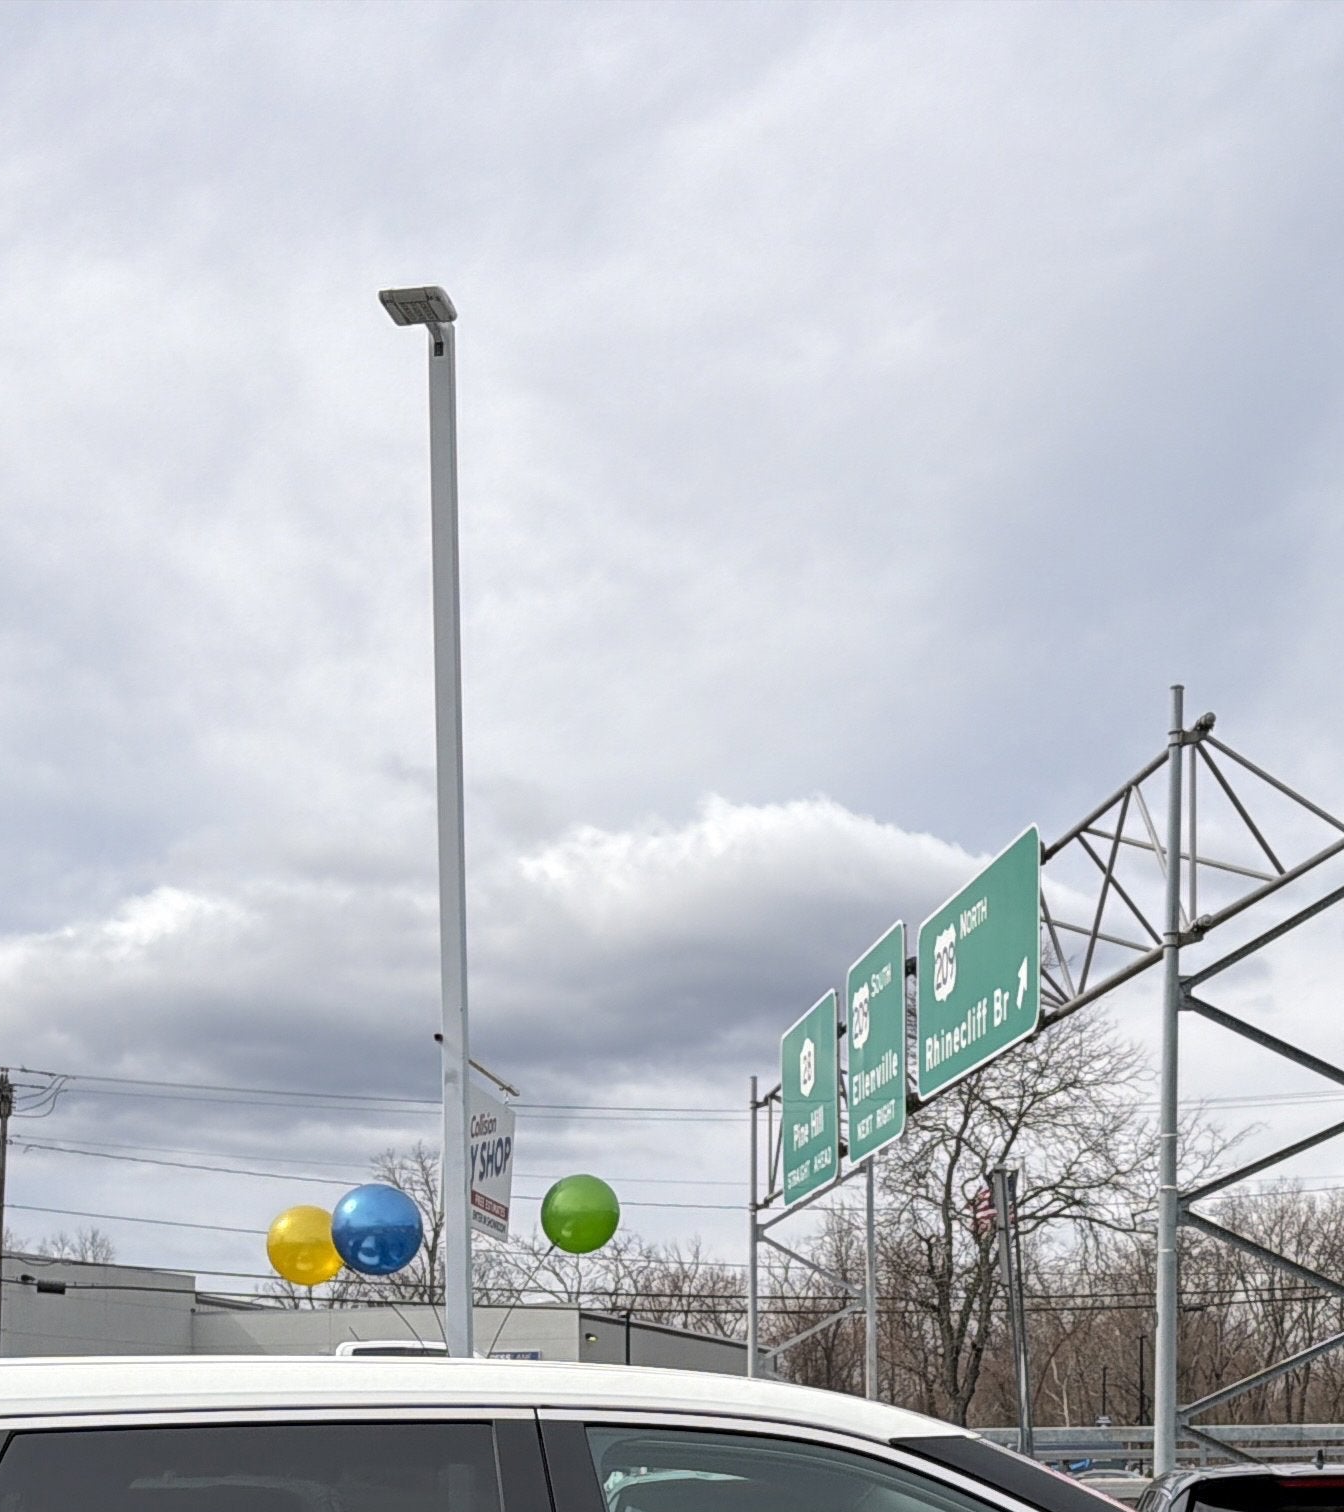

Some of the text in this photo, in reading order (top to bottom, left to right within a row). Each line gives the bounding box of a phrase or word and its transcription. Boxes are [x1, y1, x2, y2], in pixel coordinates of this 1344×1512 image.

[936, 896, 988, 991] 209 NORTH
[854, 962, 892, 1040] 209 SOUTH
[925, 987, 1010, 1073] Rhinecliff Br
[852, 1048, 898, 1107] Ellenville
[470, 1111, 497, 1138] Collision
[793, 1104, 824, 1152] Pine Hill
[857, 1099, 896, 1143] NEXT RIGHT
[478, 1136, 512, 1182] SHOP
[787, 1145, 832, 1190] STRAIGHT AHEAD
